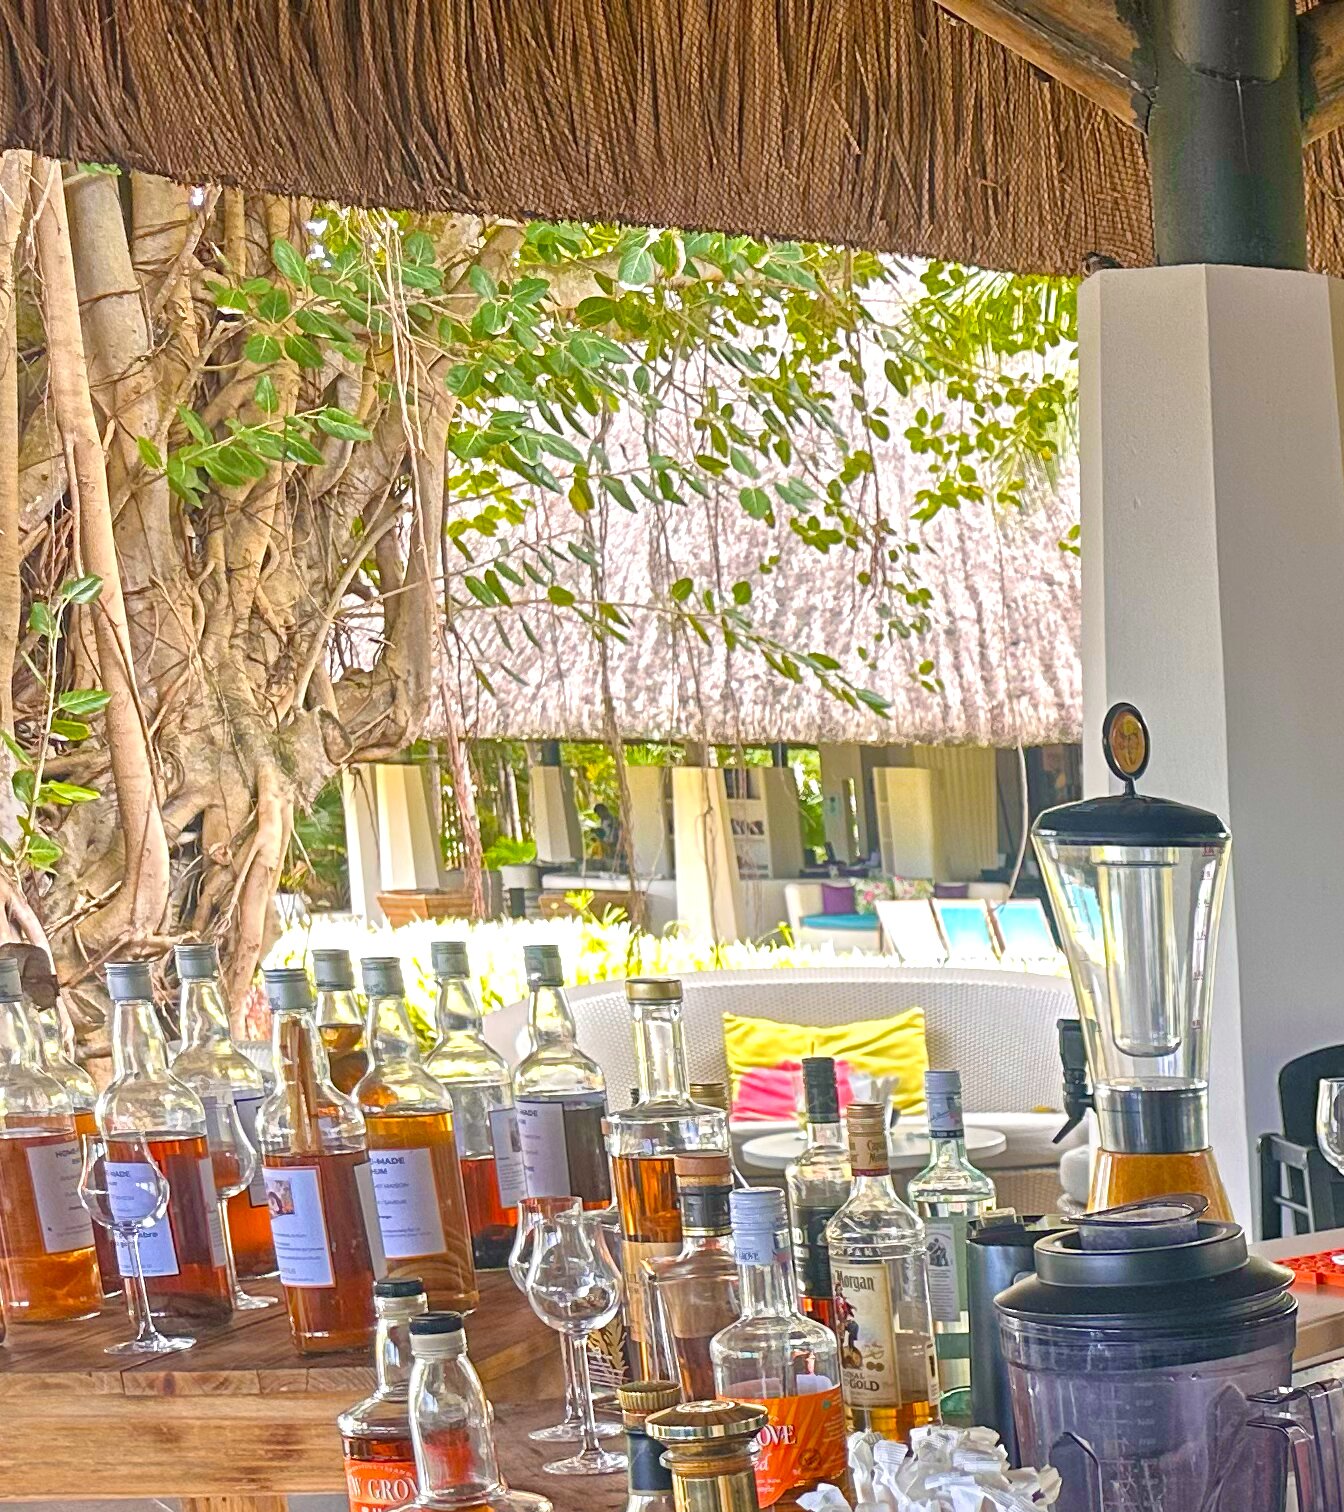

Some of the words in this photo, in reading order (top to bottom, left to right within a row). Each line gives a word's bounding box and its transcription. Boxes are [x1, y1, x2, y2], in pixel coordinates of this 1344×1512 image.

[834, 1269, 875, 1292] Morgan
[849, 1380, 880, 1392] GOLD
[756, 1424, 797, 1447] OVE
[367, 1478, 419, 1502] GROV
